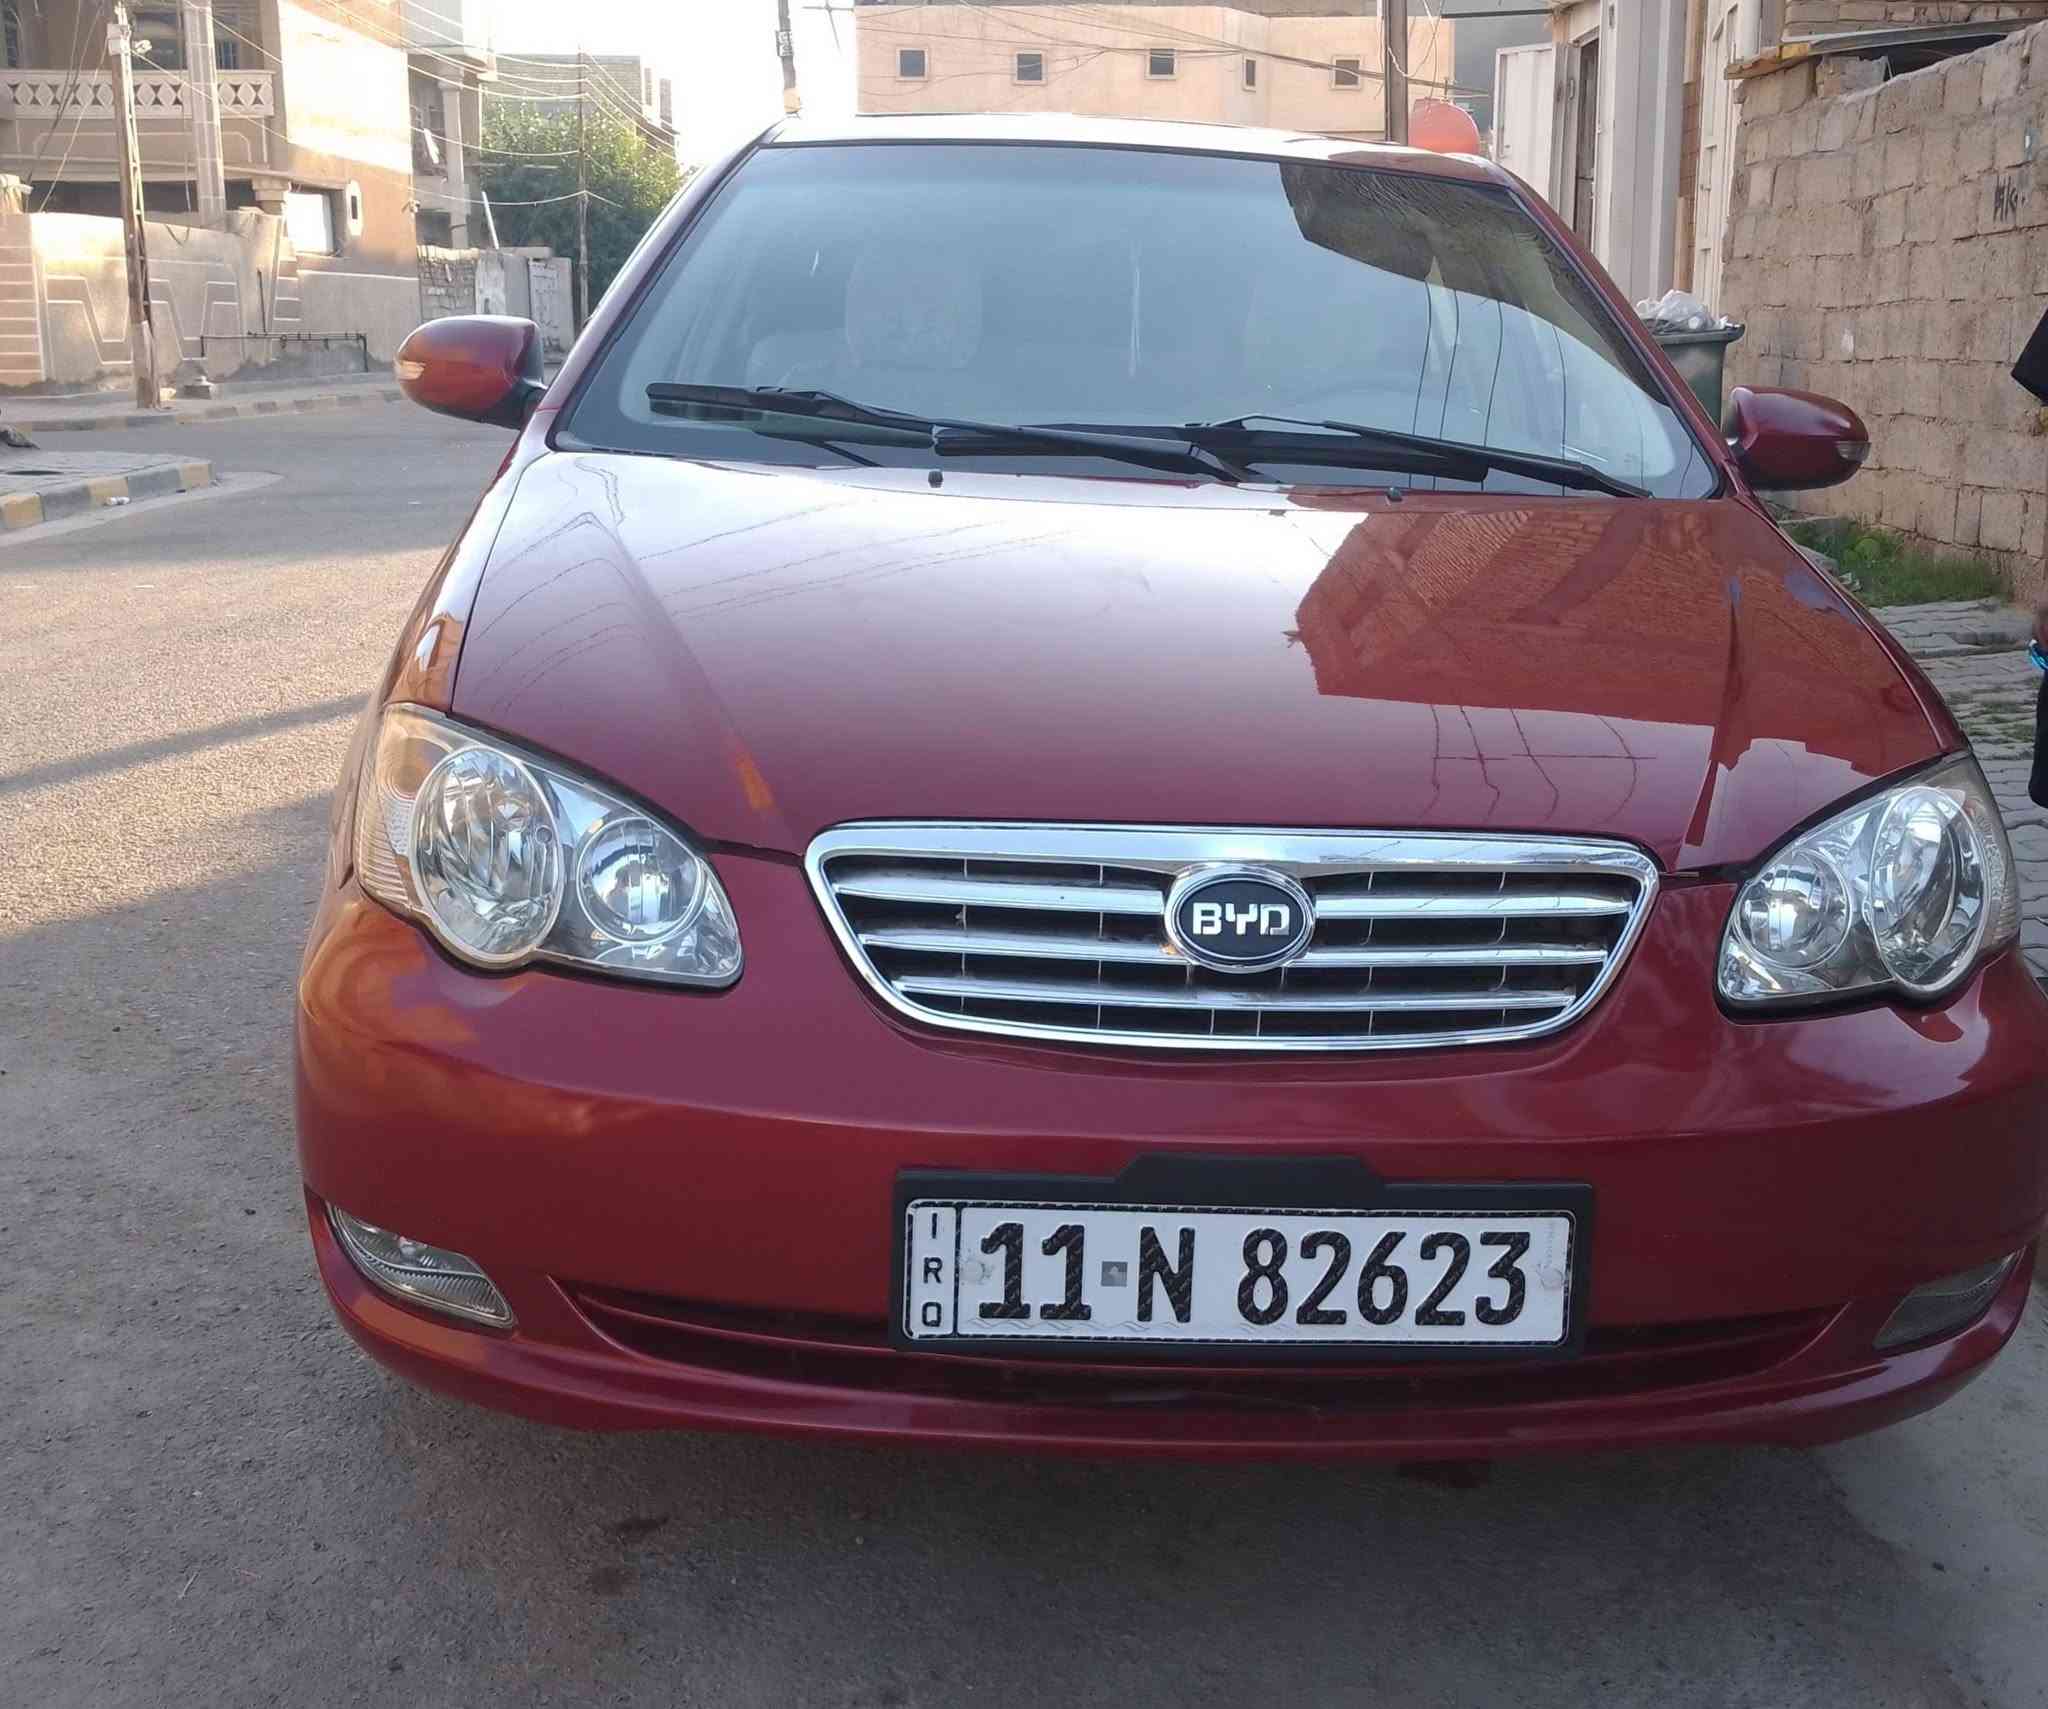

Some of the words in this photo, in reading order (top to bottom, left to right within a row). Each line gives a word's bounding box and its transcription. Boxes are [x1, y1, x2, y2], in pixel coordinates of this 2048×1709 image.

[1192, 902, 1290, 936] BYD
[978, 1222, 1092, 1320] 11
[1137, 1226, 1196, 1324] N
[1237, 1228, 1531, 1327] 82623
